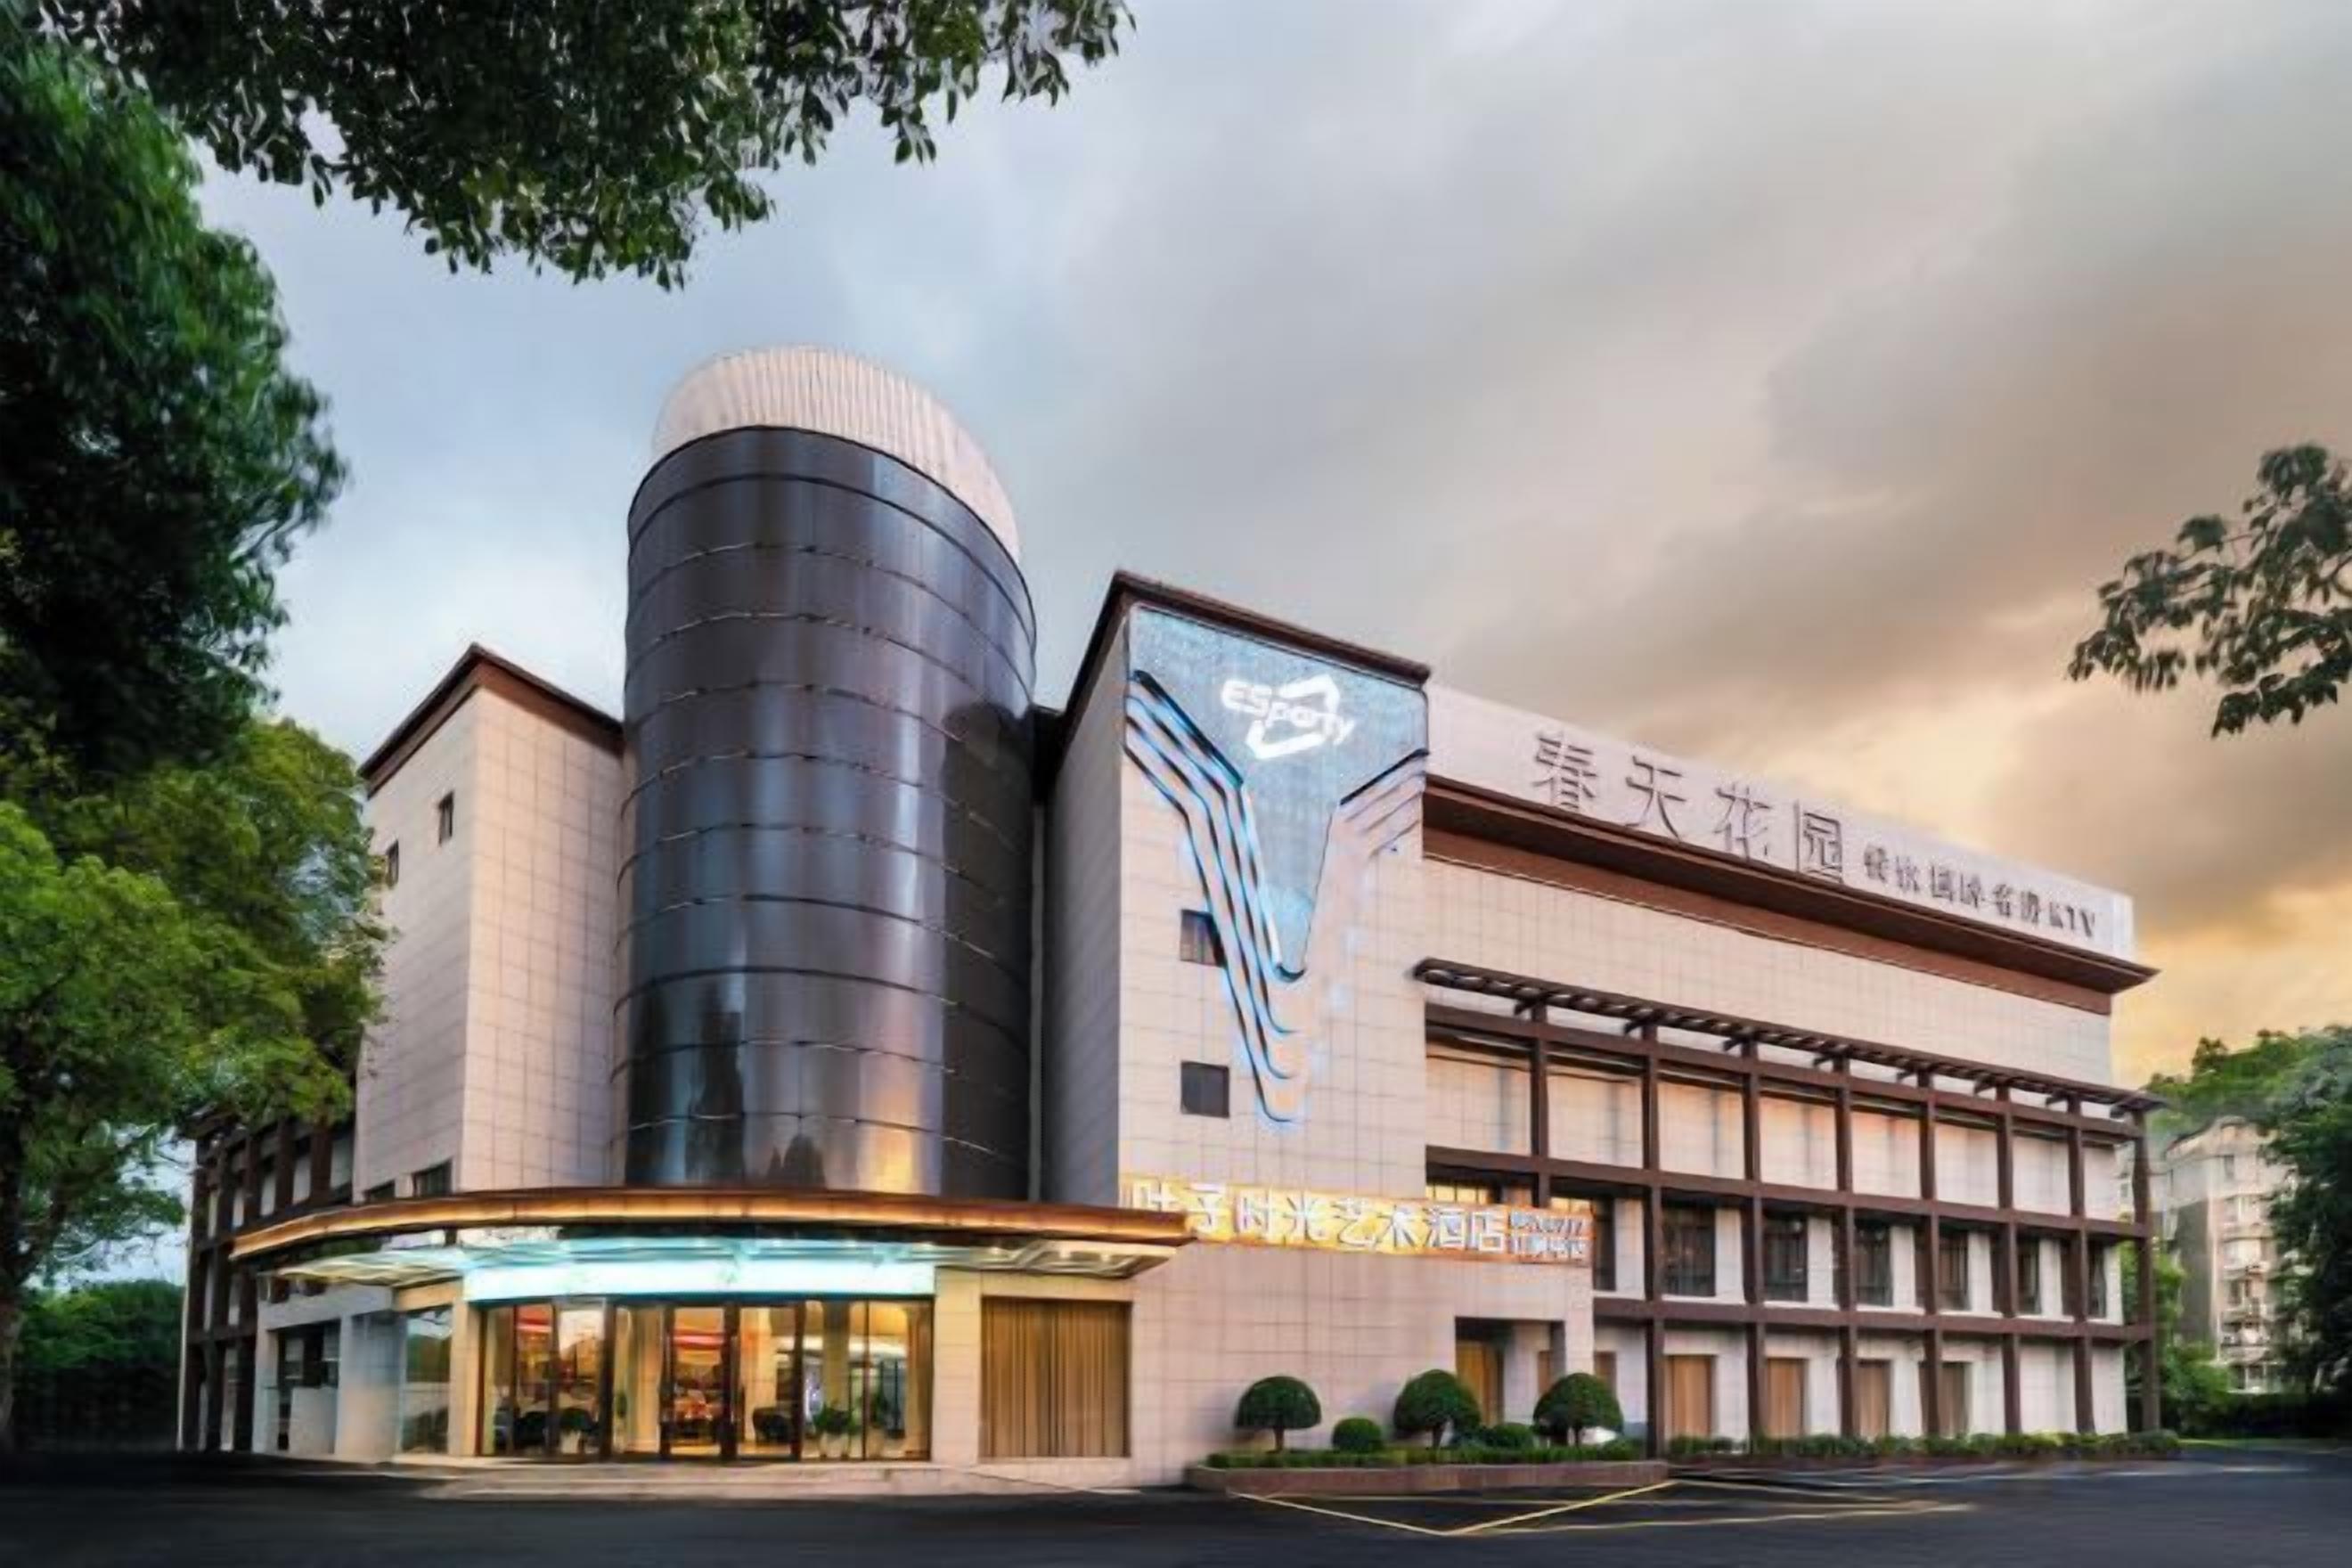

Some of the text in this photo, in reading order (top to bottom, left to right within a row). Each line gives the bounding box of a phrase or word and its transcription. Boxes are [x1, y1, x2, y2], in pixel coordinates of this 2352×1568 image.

[1531, 731, 1843, 884] 春天花园
[1131, 1181, 1506, 1253] 叶子时光艺术酒店
